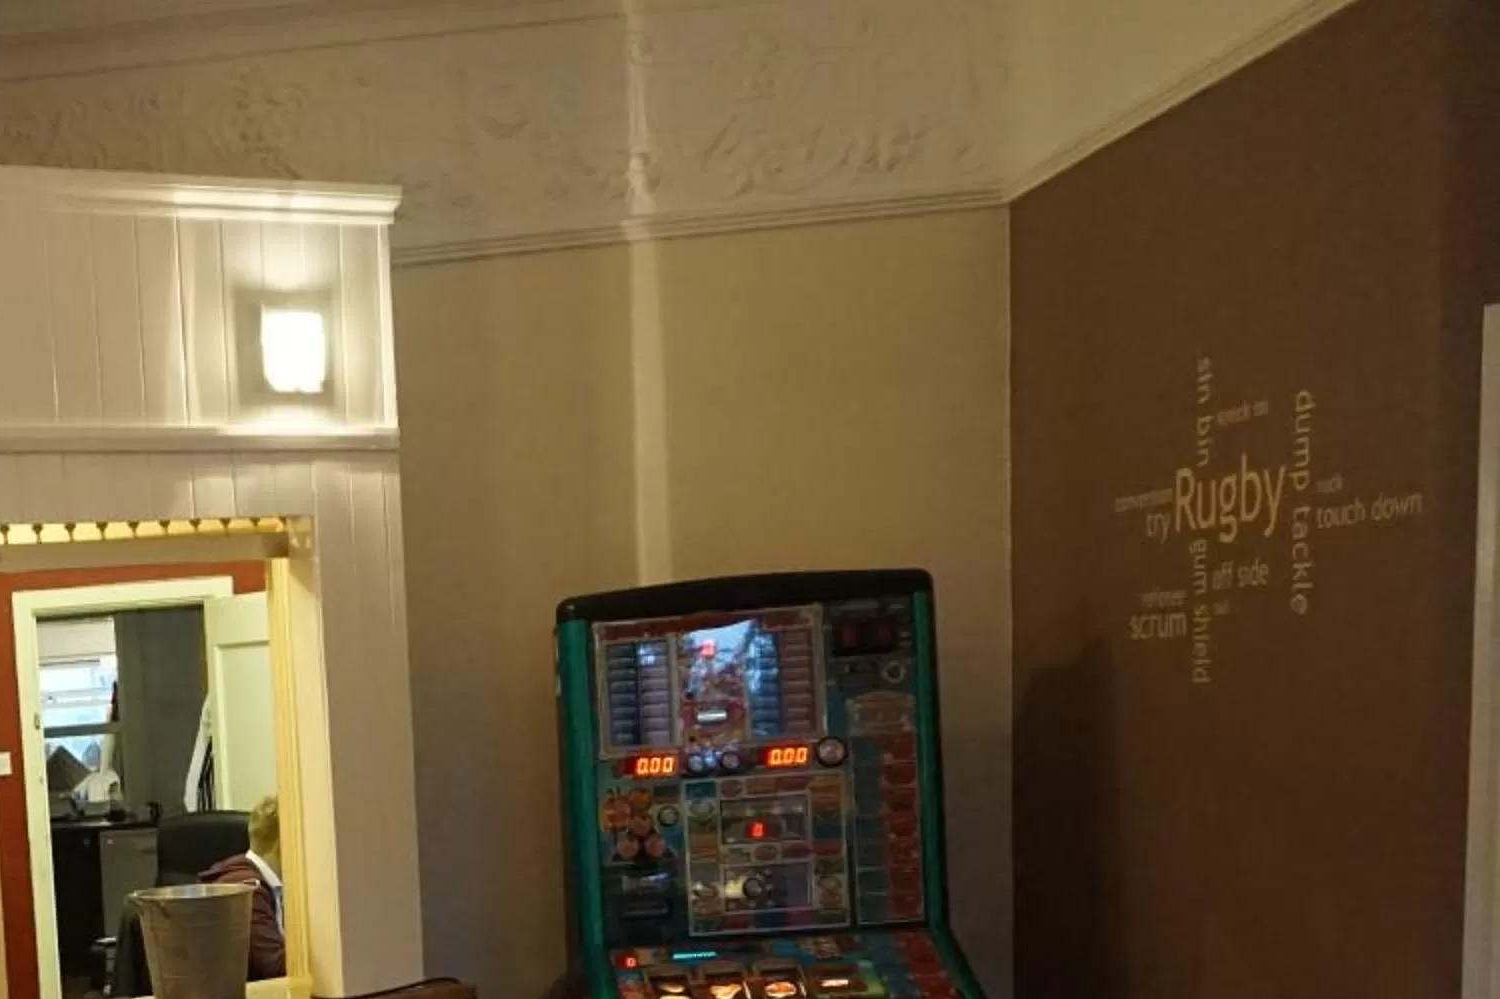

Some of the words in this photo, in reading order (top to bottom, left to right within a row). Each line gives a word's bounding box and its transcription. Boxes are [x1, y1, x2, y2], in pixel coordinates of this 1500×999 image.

[1196, 357, 1213, 405] sin
[1196, 416, 1215, 467] bin
[1289, 389, 1317, 492] dump
[1174, 452, 1286, 544] Rugby
[1316, 498, 1366, 529] touch
[1370, 492, 1423, 522] down
[1145, 509, 1172, 544] try
[1188, 539, 1207, 596] gum
[1211, 558, 1233, 591] off
[1237, 555, 1269, 588] side
[1290, 506, 1314, 616] tackle
[1129, 611, 1188, 640] scrum
[1191, 604, 1213, 684] shield
